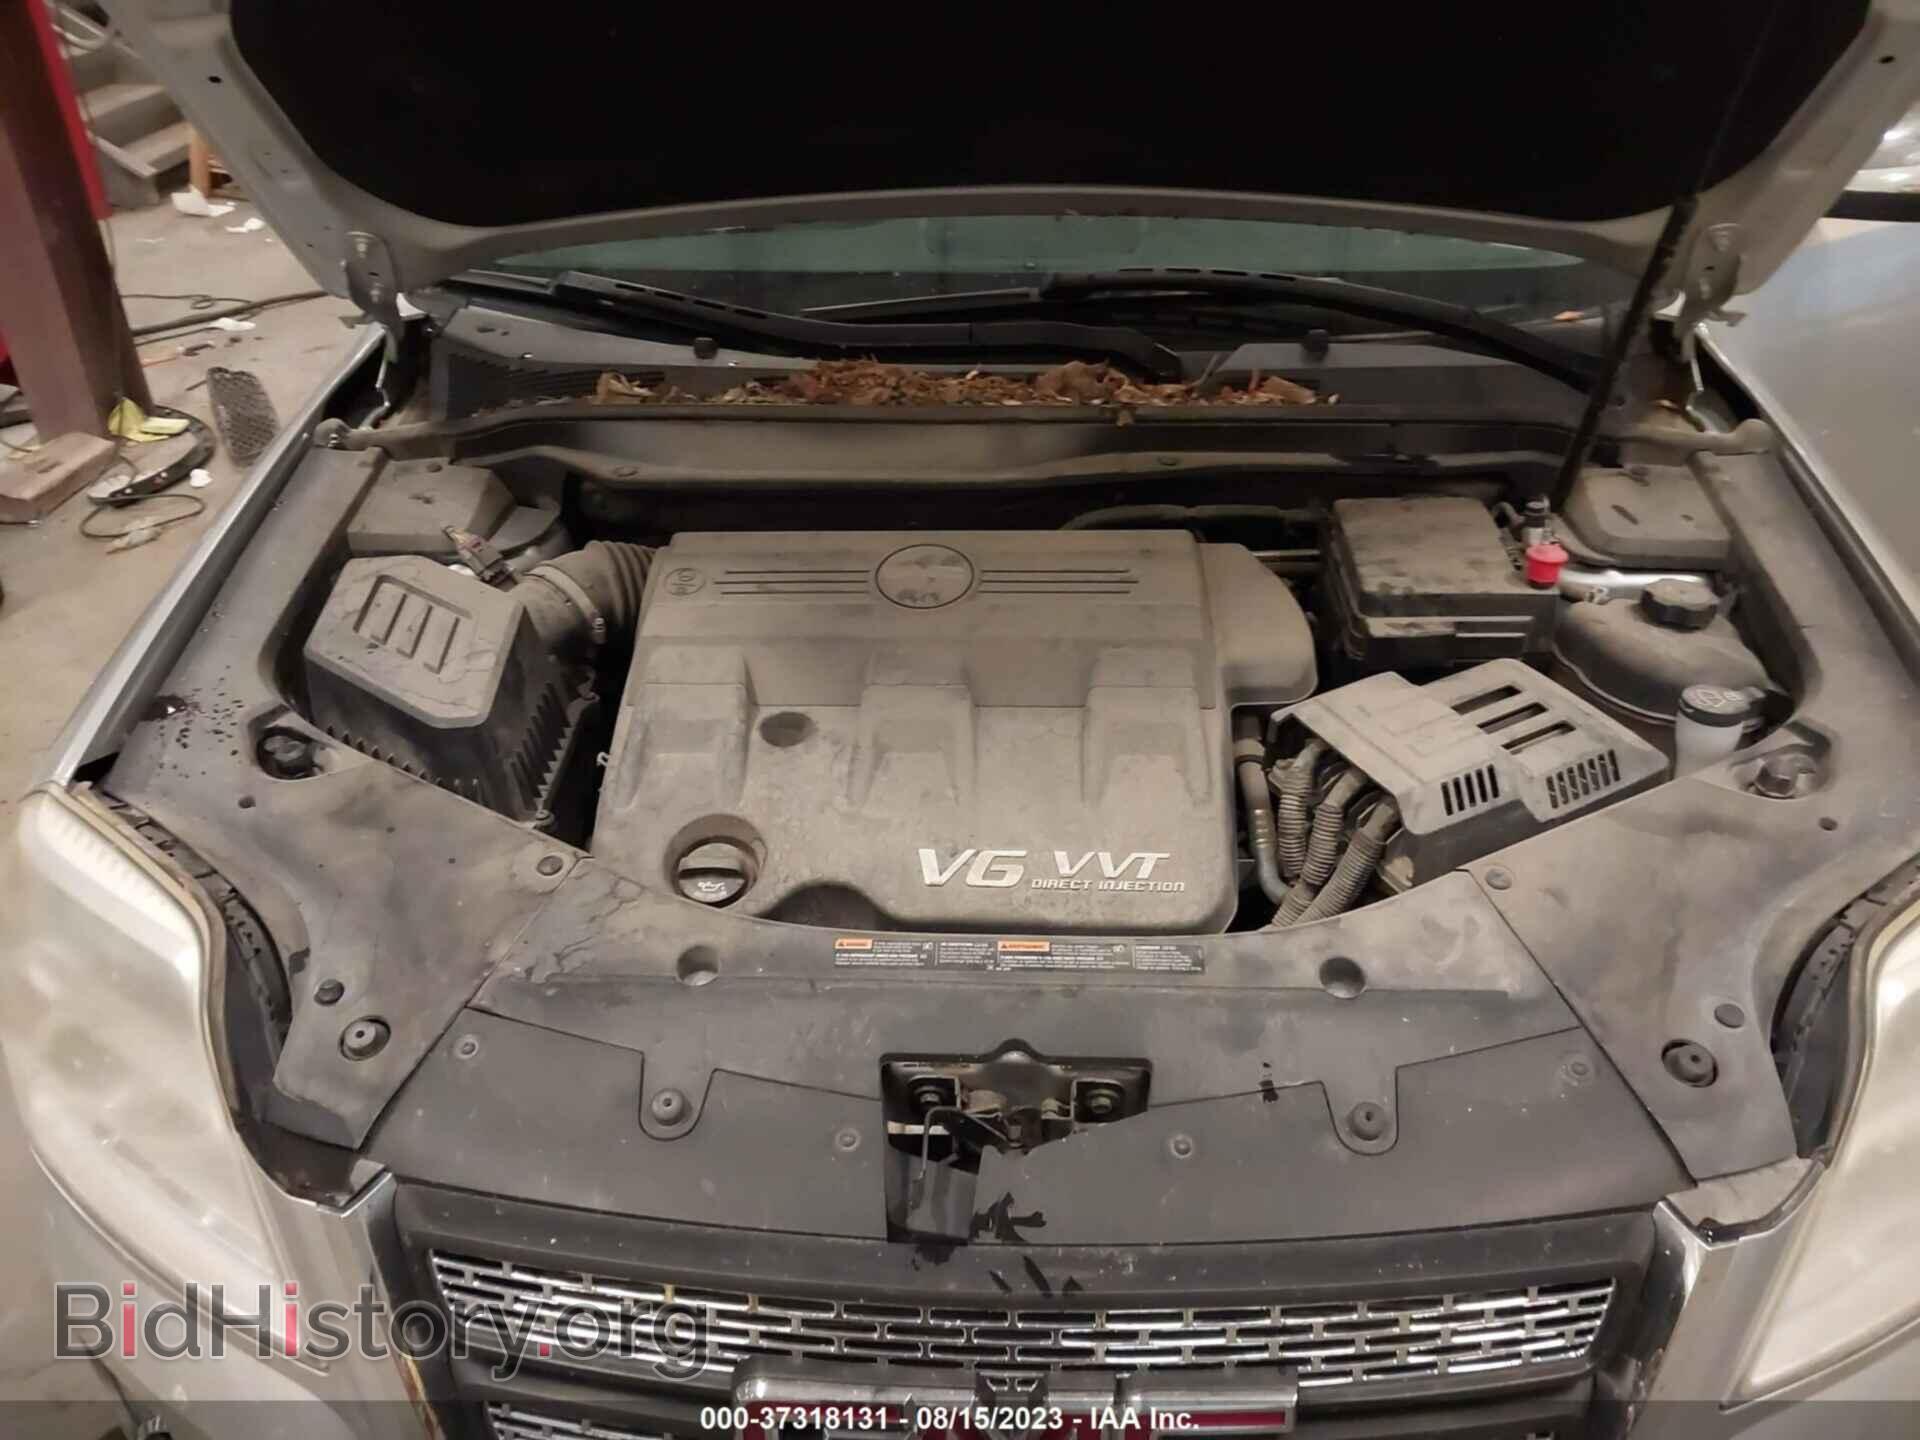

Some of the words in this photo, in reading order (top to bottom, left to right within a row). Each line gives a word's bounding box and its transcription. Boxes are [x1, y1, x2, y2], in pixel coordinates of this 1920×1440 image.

[918, 848, 1027, 887] V6
[1054, 850, 1170, 879] VVT
[1031, 879, 1092, 889] DIRECT
[1097, 880, 1185, 891] INJECTION
